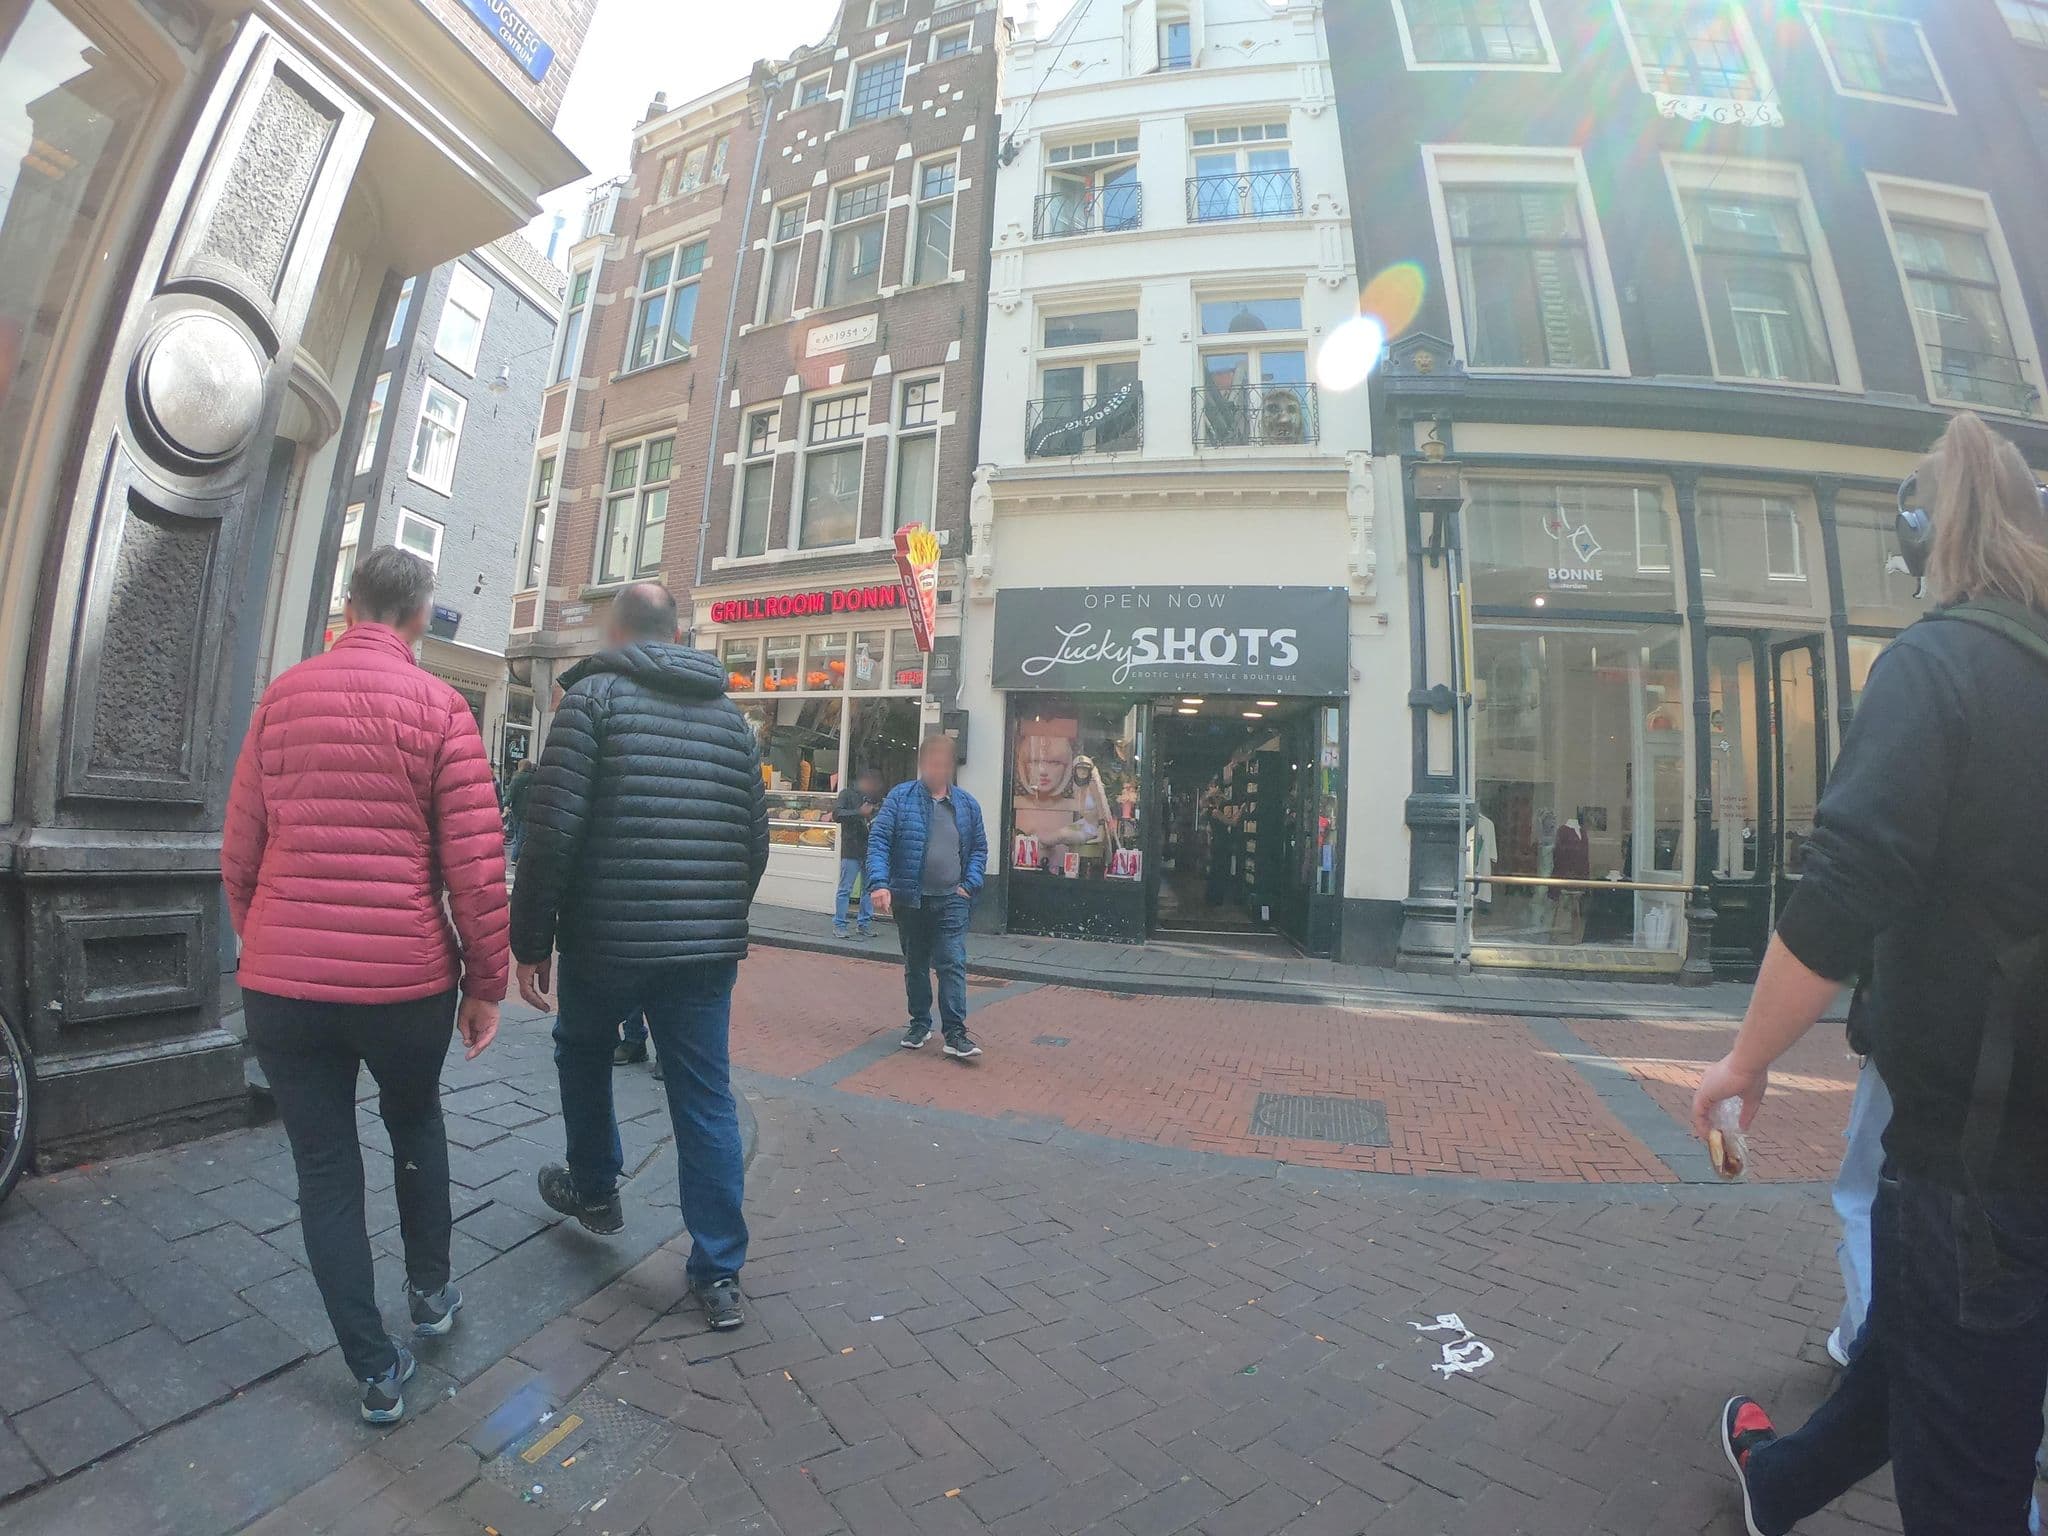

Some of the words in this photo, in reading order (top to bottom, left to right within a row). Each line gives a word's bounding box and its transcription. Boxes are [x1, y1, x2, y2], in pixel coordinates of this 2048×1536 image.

[485, 0, 540, 53] UGSTEEG
[499, 26, 533, 64] CENTRUM
[1548, 567, 1603, 582] BONNE
[711, 592, 824, 622] GRILLROOM
[903, 574, 923, 634] DONNY
[1084, 593, 1151, 609] OPEN
[1168, 592, 1226, 609] NOW
[1021, 622, 1135, 685] Lucky
[1131, 627, 1299, 668] SHOTS
[1131, 671, 1169, 679] EROTIC
[1174, 671, 1198, 680] LIFE
[1203, 672, 1237, 680] STYLE
[1243, 672, 1298, 682] BOUTIQUE
